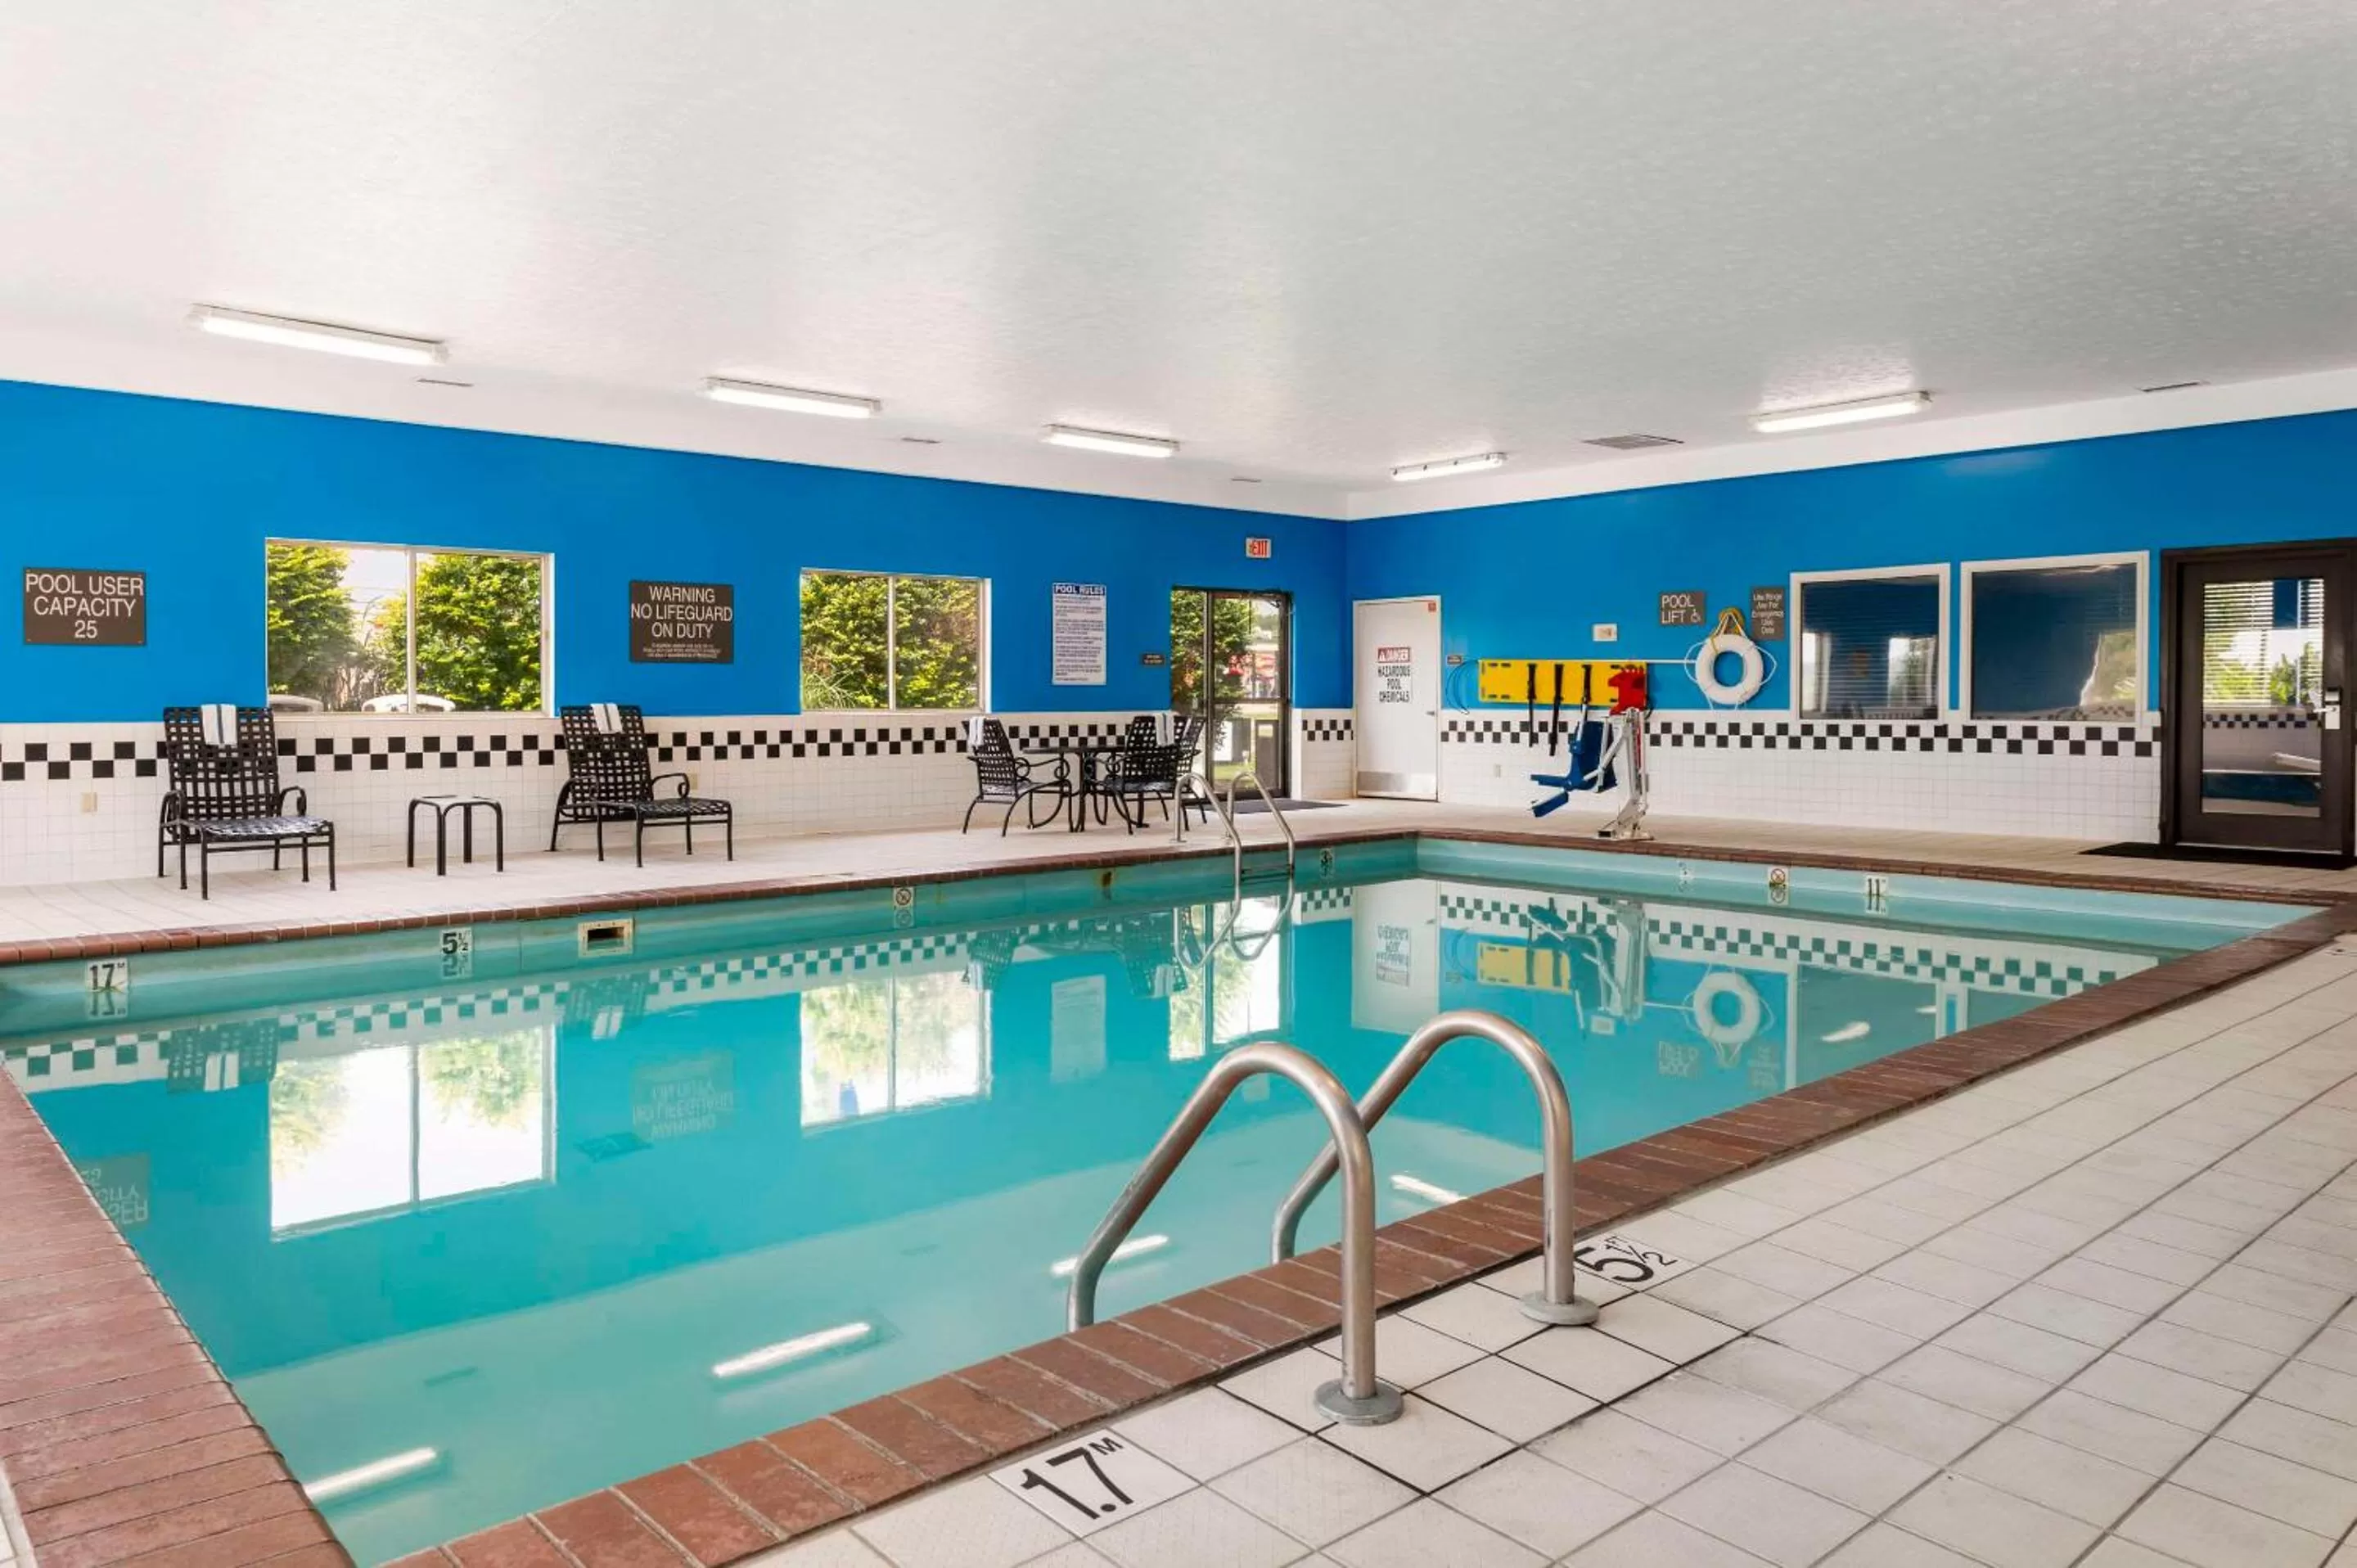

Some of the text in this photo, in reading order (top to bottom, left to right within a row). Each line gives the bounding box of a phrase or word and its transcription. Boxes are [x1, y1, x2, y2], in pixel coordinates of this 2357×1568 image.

[1251, 540, 1268, 556] EXIT
[25, 573, 144, 597] POOL USER
[1055, 584, 1077, 594] POOL
[648, 585, 715, 604] WARNING
[1661, 594, 1694, 609] POOL
[34, 596, 137, 617] CAPACITY
[631, 603, 733, 622] NO LIFEGUARD
[1661, 609, 1685, 624] LIFT
[74, 620, 98, 638] 25
[651, 622, 714, 638] ON DUTY
[1378, 665, 1410, 678] HAZARDOUS
[1387, 678, 1401, 690] POOL
[1379, 691, 1409, 703] CHEMICALS
